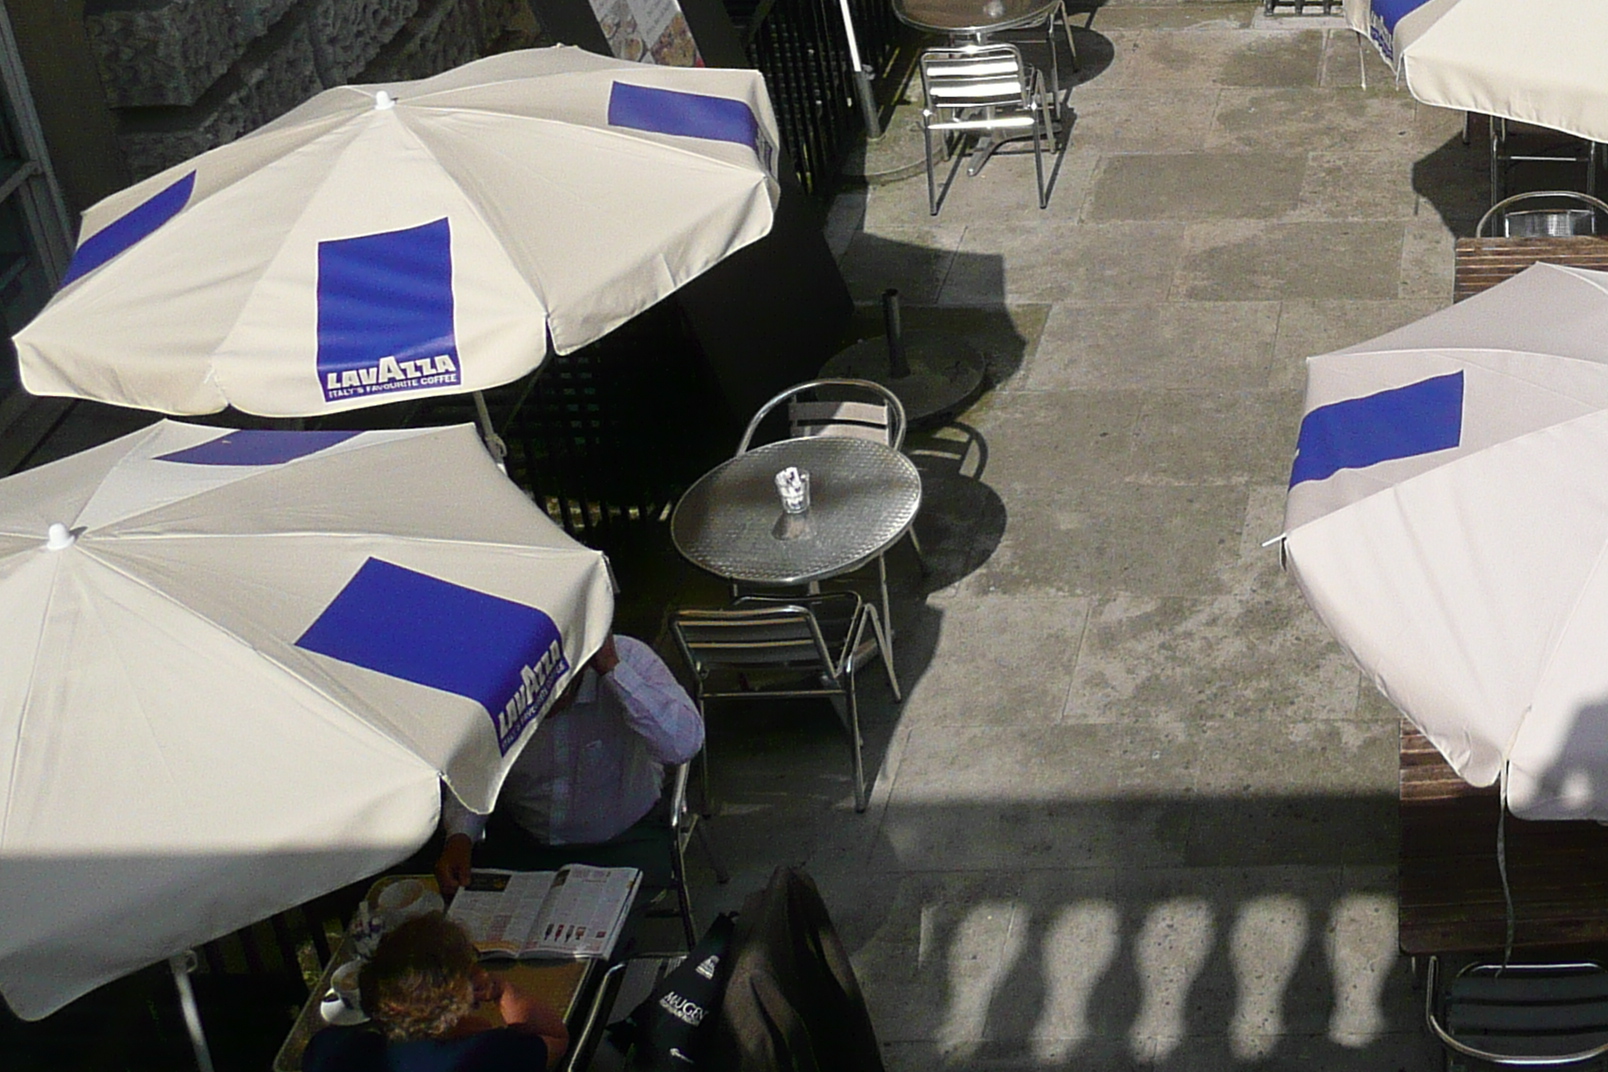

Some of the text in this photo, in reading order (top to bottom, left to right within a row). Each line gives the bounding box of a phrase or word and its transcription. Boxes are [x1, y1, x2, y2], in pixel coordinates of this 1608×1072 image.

[327, 355, 457, 390] LAVAZZA
[328, 373, 458, 399] ITALY'S FAVOURITE COFFEE
[498, 639, 561, 740] LAVAZZA
